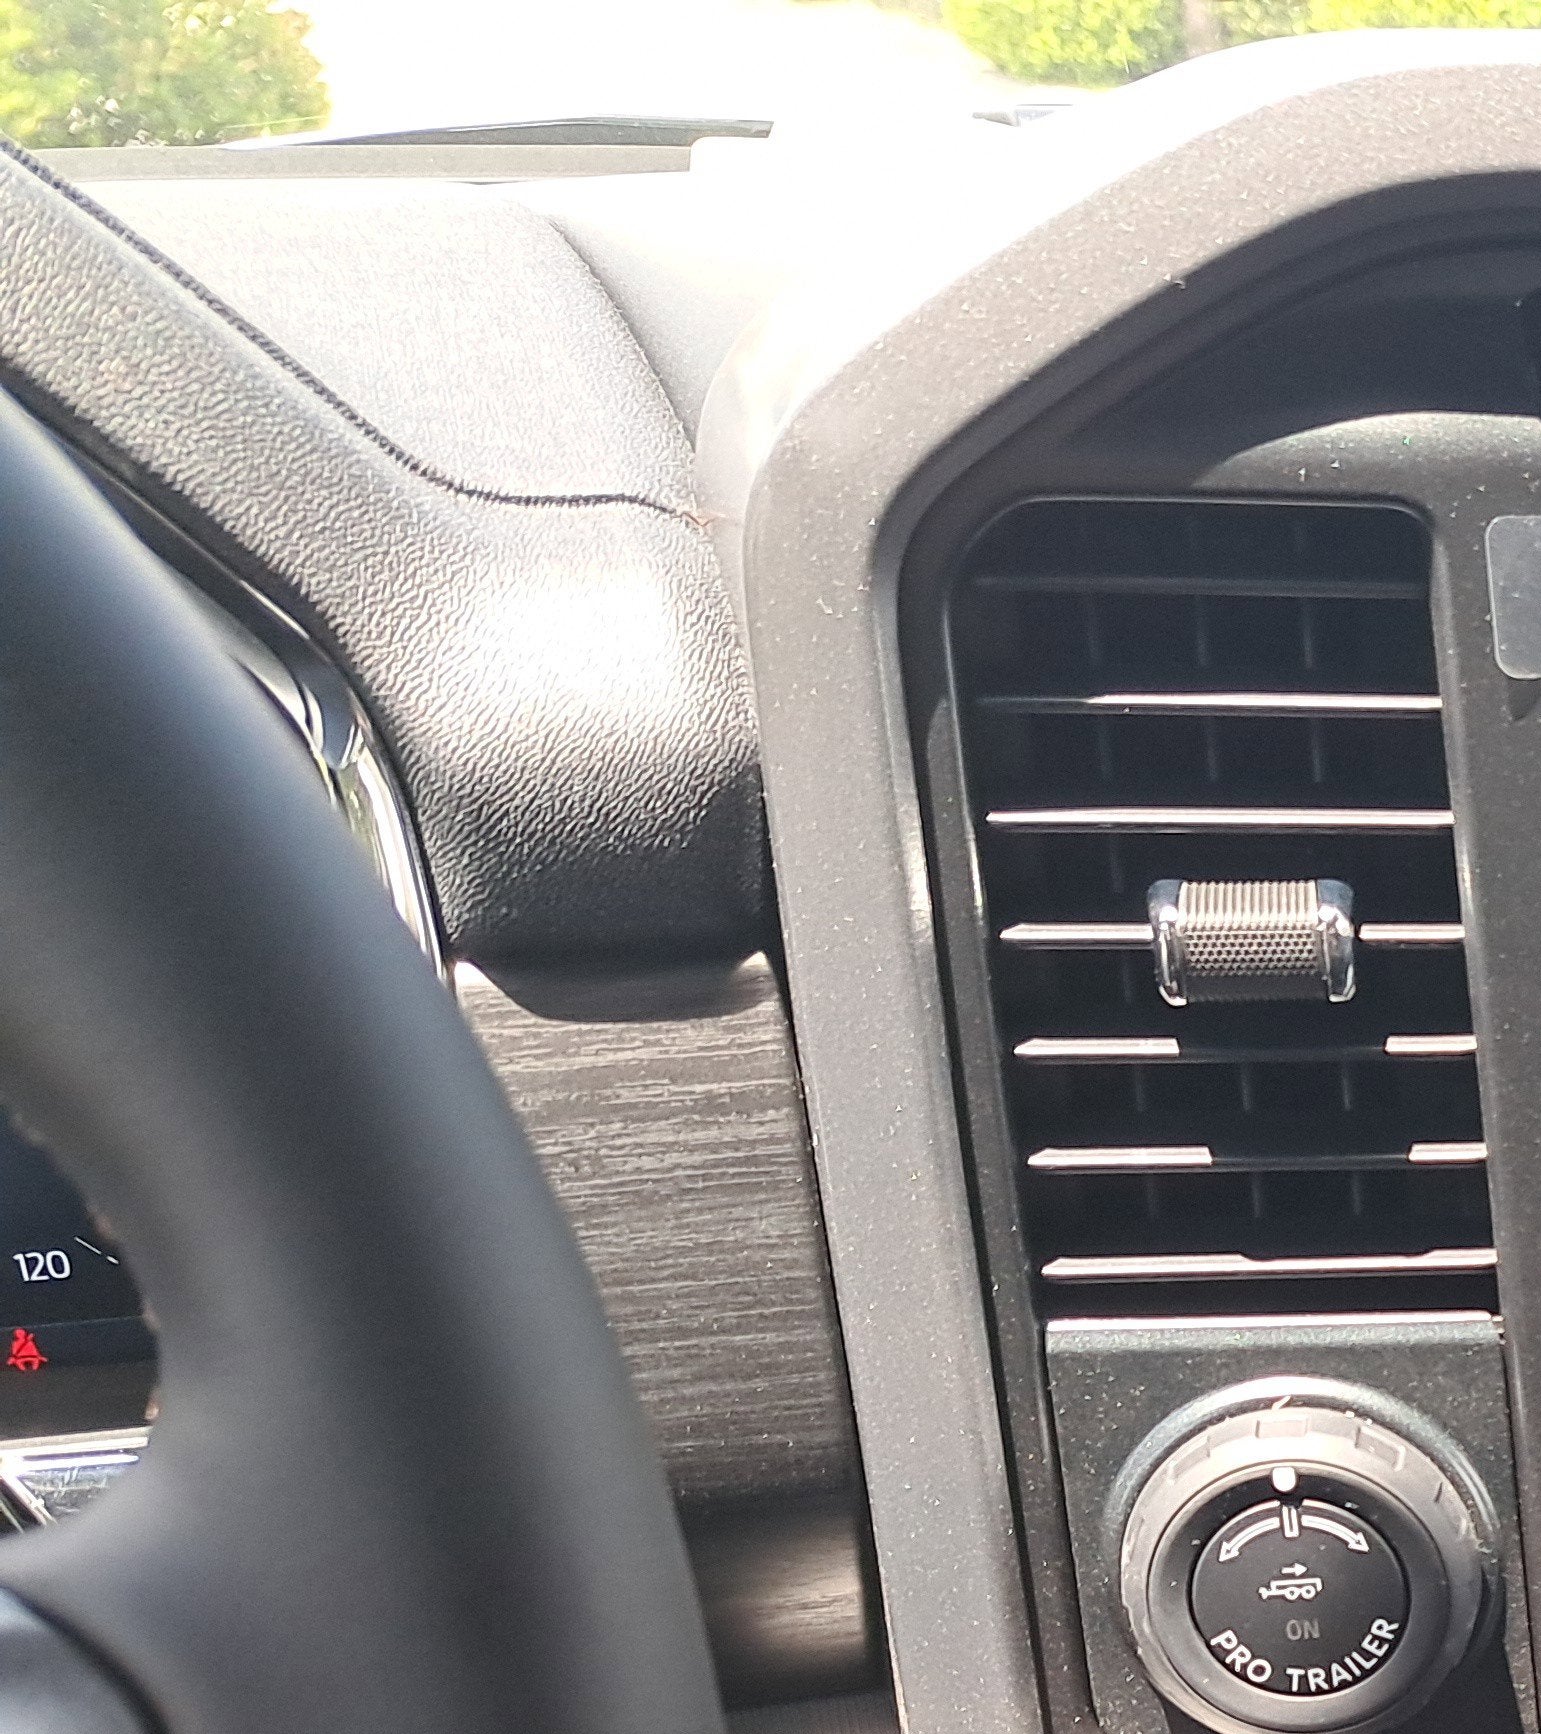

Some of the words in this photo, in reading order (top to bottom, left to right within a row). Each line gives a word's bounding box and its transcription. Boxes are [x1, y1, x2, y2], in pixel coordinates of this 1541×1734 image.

[12, 1250, 71, 1282] 120
[1286, 1619, 1320, 1641] ON
[1210, 1630, 1272, 1683] PRO
[1286, 1617, 1399, 1693] TRAILER
